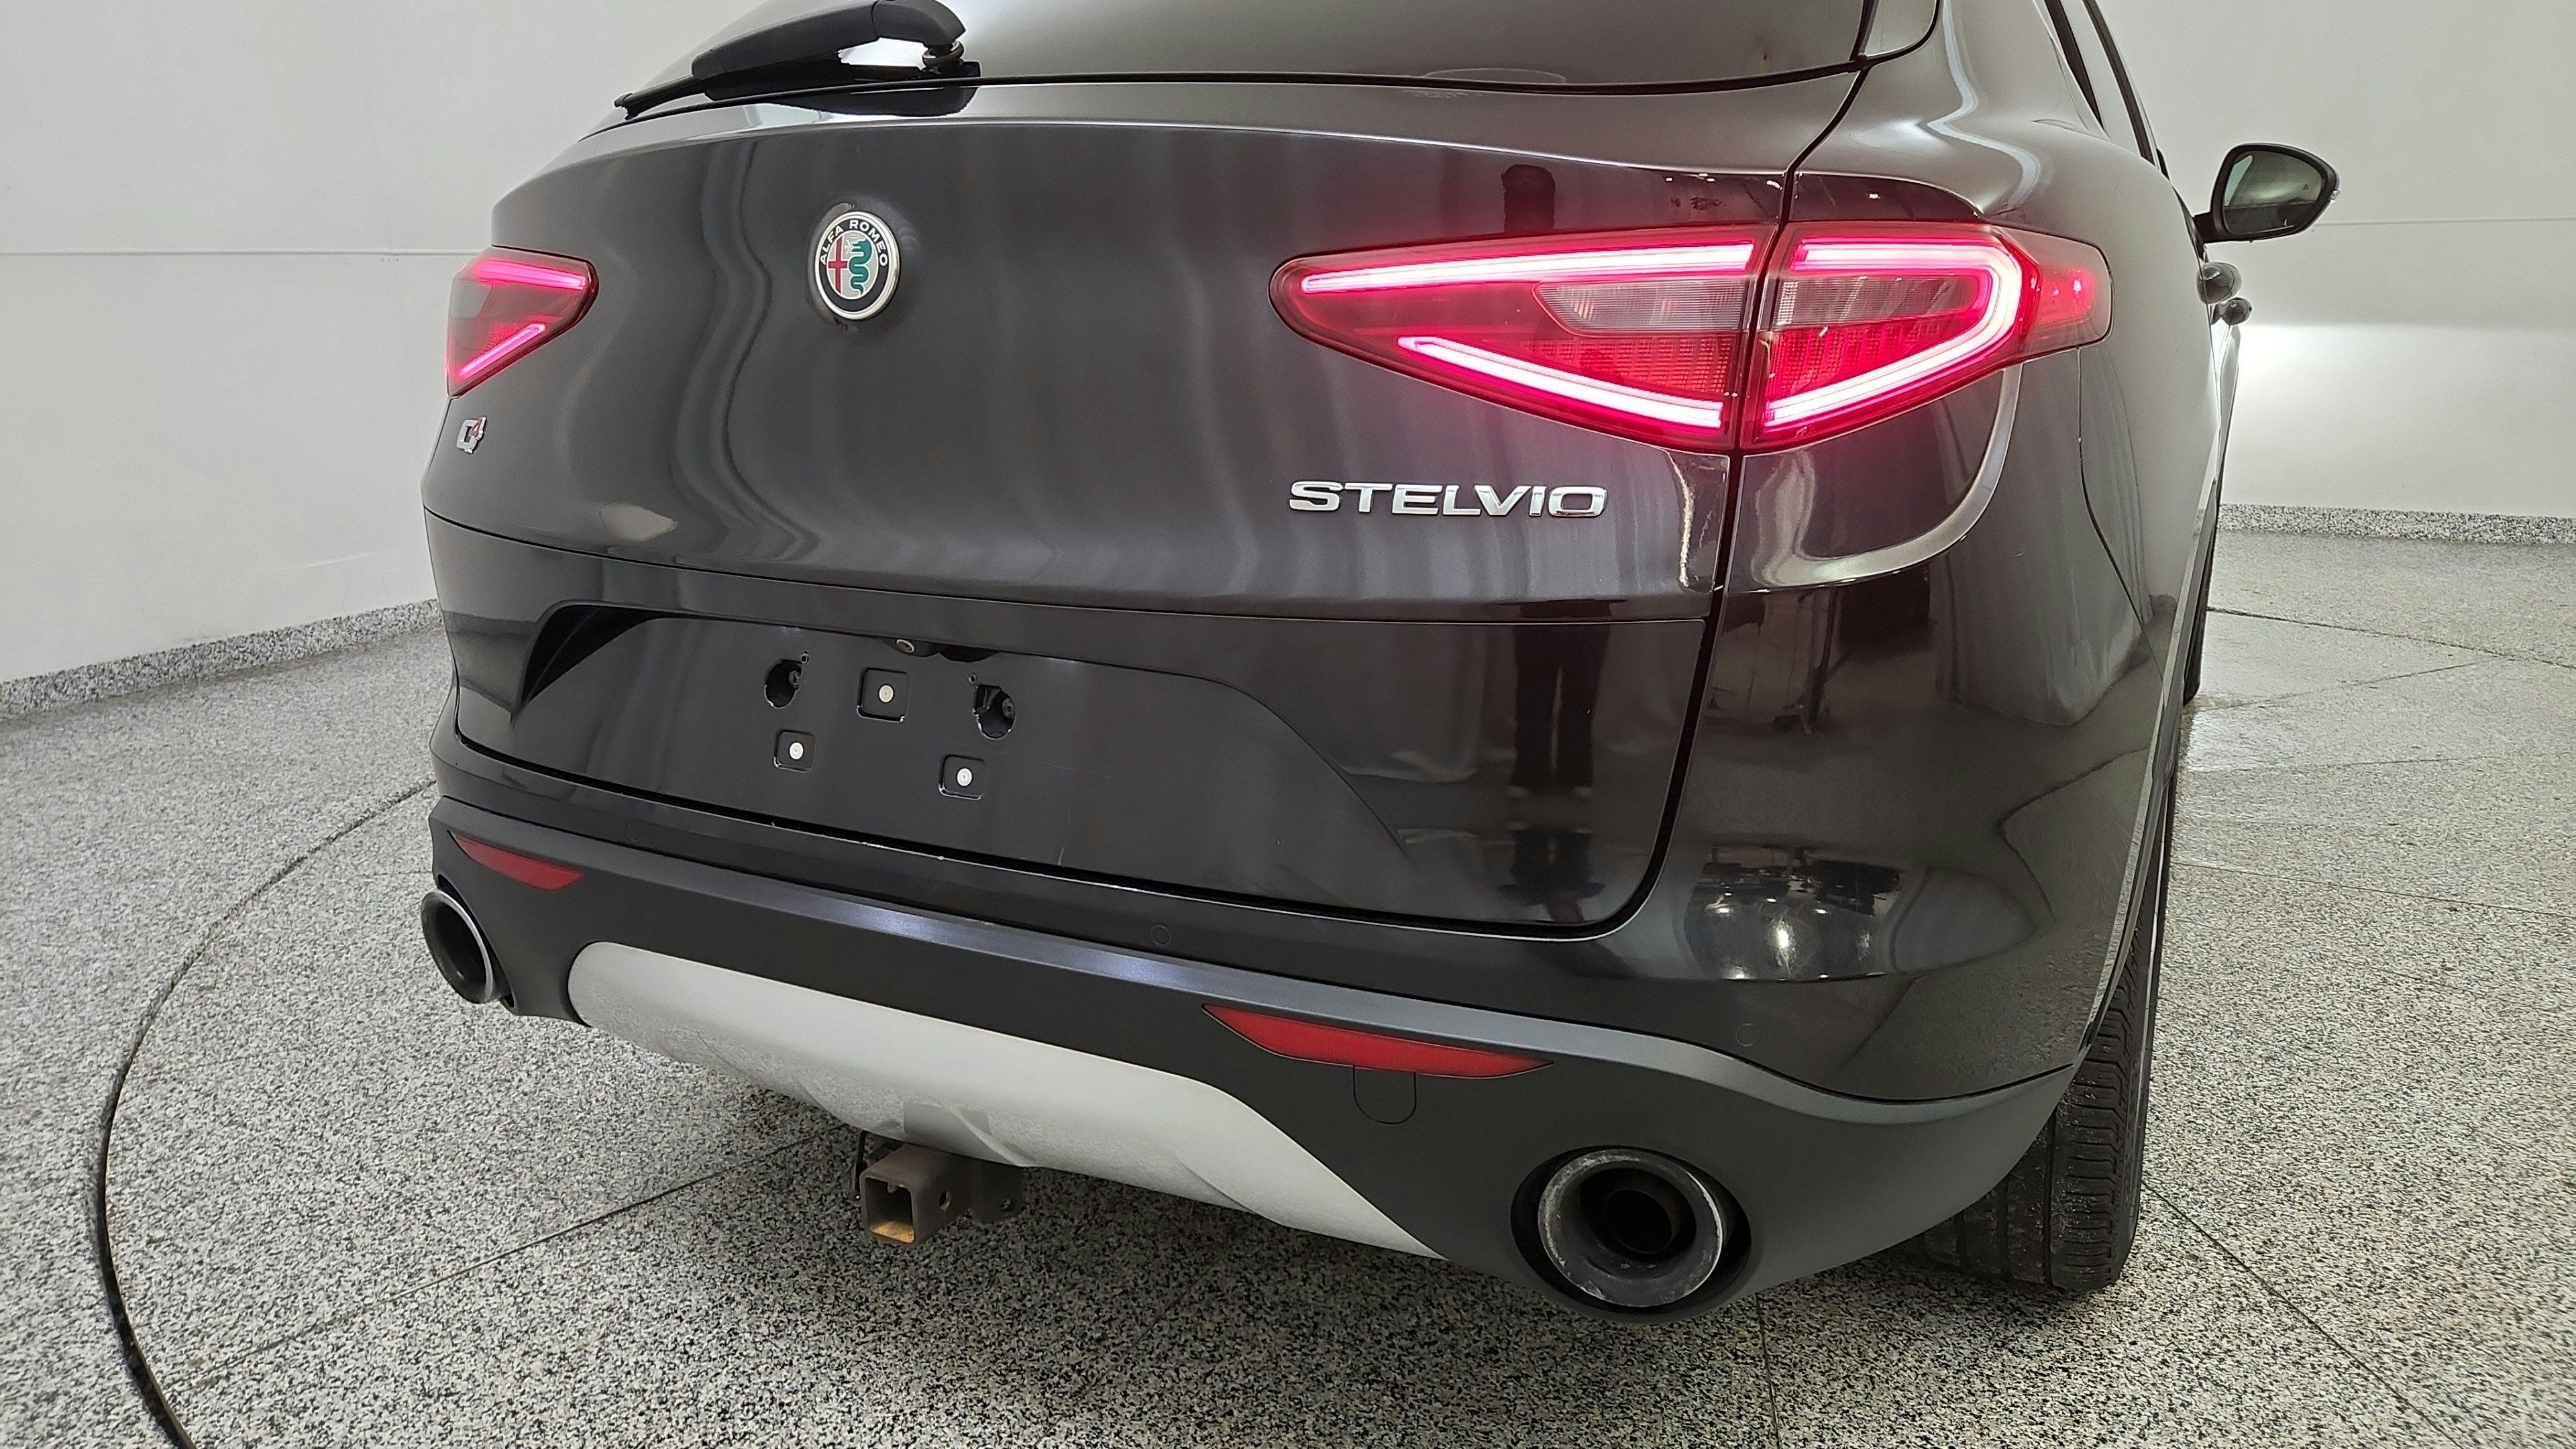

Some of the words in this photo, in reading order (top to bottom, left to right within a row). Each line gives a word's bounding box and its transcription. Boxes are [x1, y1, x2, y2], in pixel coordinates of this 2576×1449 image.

[820, 225, 844, 266] ALFA
[849, 219, 888, 266] ROMEO
[1289, 480, 1608, 518] STELVIO
